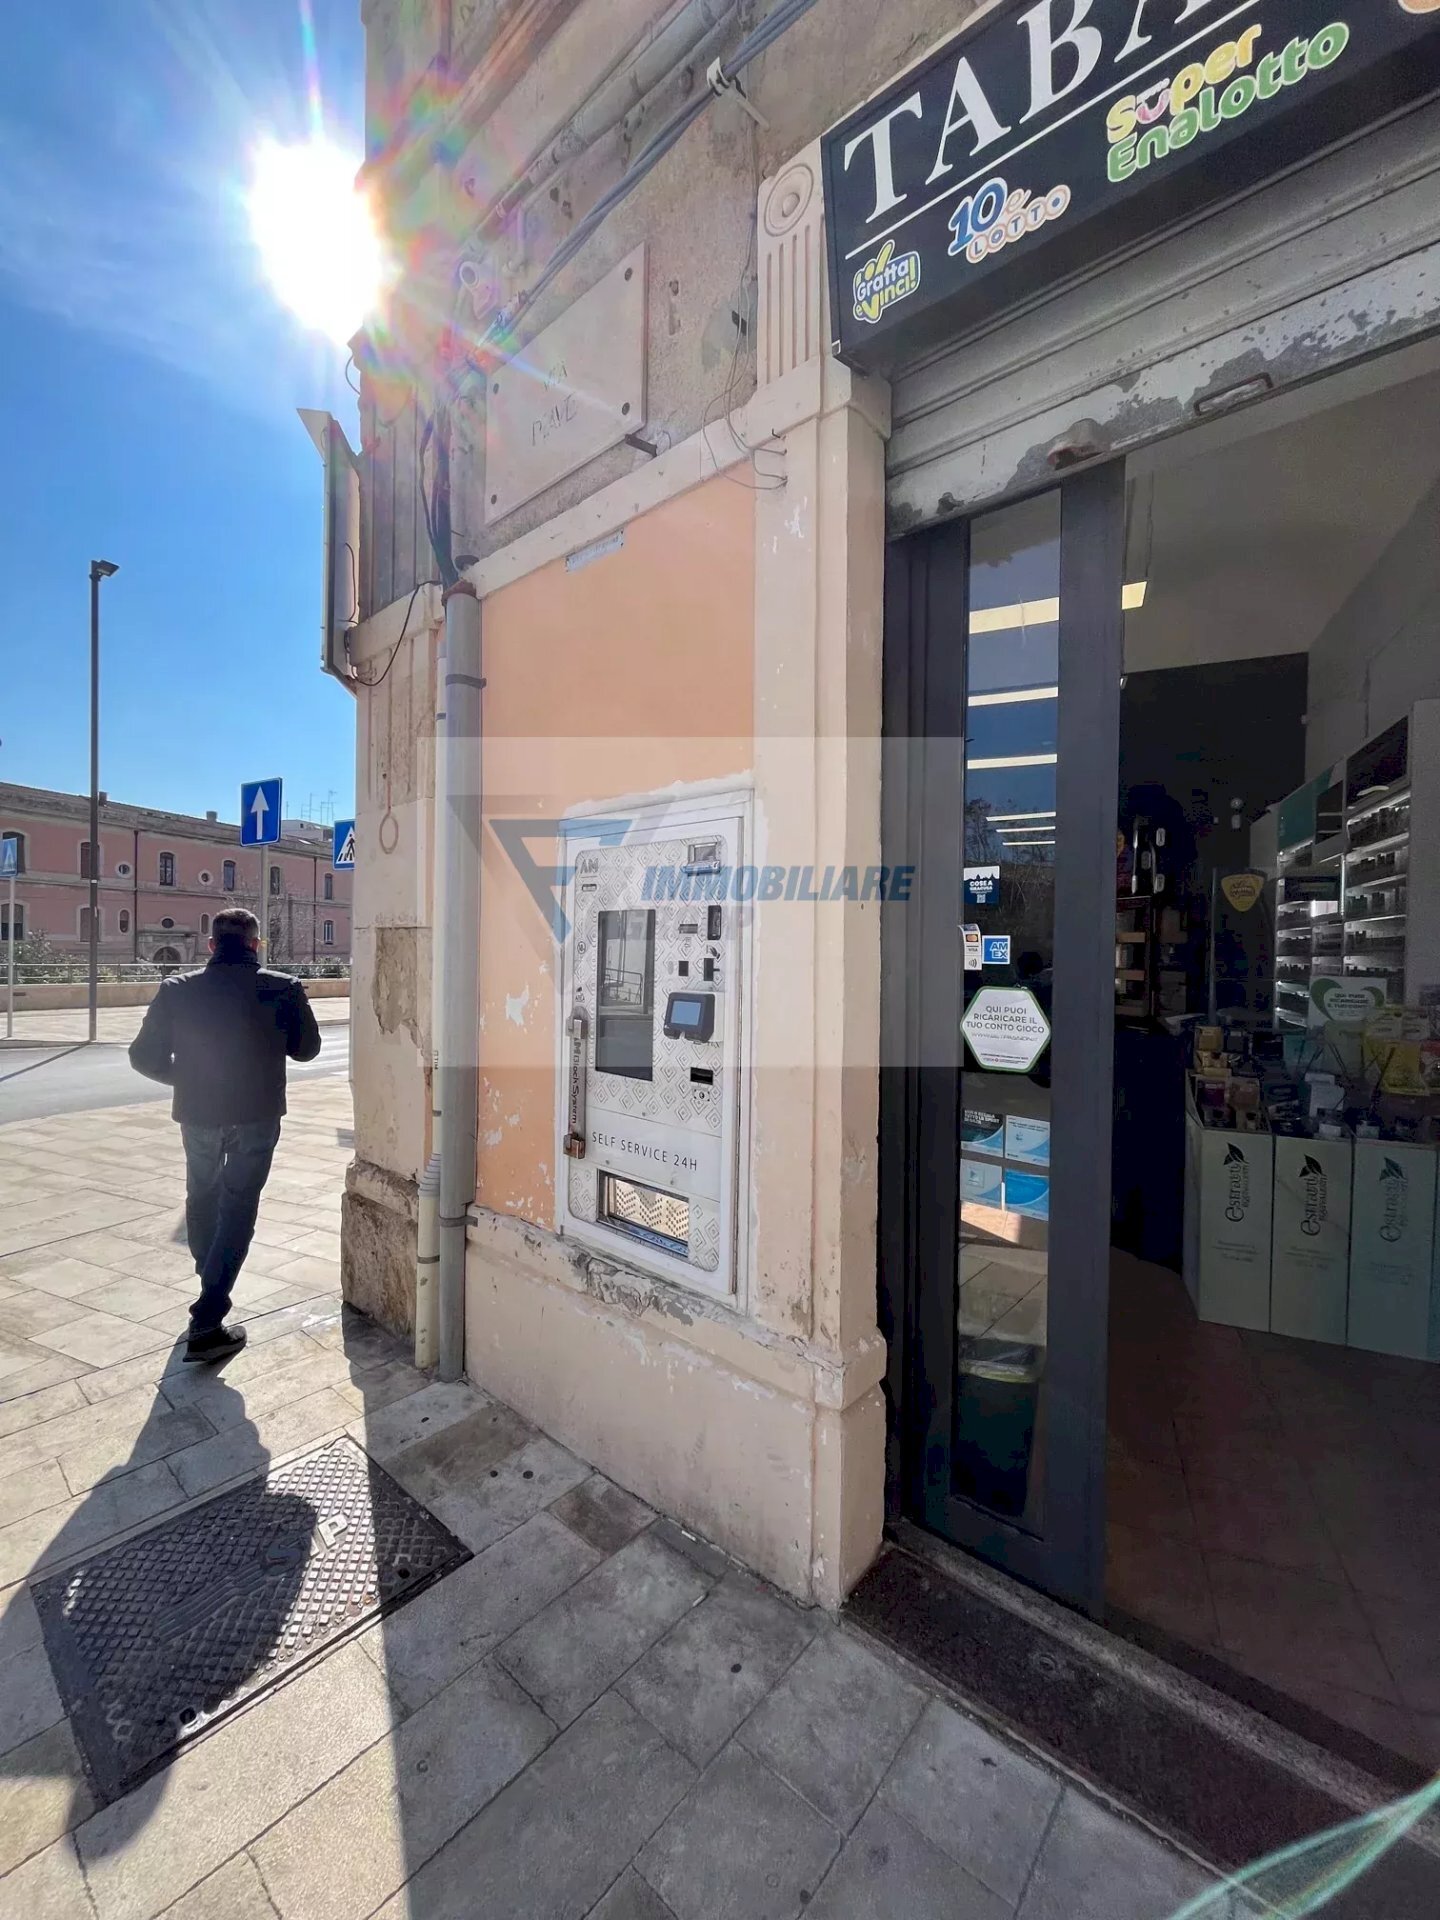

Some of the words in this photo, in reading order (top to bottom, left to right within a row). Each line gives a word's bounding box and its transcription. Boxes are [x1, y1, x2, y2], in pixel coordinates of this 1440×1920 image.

[1107, 24, 1262, 143] Super
[1107, 22, 1350, 182] Enalotto
[967, 184, 1071, 263] LOTTO
[857, 259, 909, 301] Gratta
[966, 1021, 983, 1029] TUO
[984, 1022, 1014, 1031] CONTO
[1016, 1025, 1045, 1034] GIOCO
[973, 1013, 1027, 1024] RICARICARE
[1029, 1017, 1037, 1025] IL
[985, 1005, 1002, 1013] QUI
[1004, 1006, 1027, 1015] PUOI
[592, 1131, 616, 1148] SELF
[620, 1139, 668, 1164] SERVICE
[673, 1153, 698, 1172] 24H
